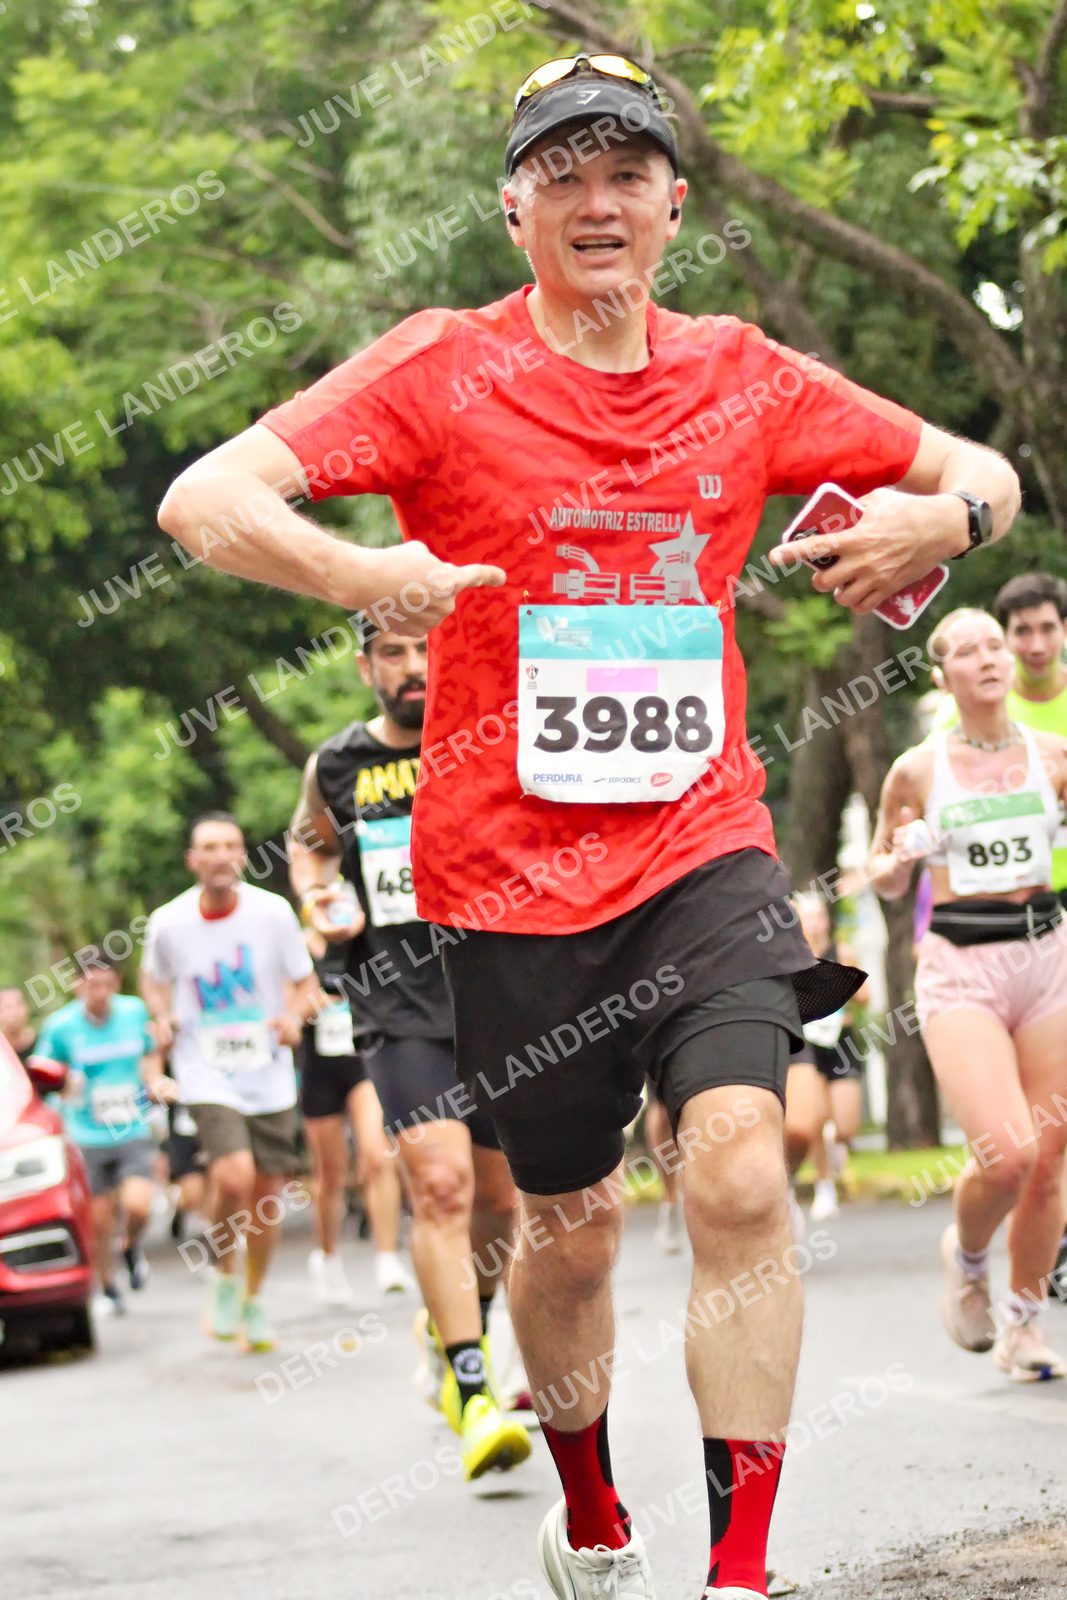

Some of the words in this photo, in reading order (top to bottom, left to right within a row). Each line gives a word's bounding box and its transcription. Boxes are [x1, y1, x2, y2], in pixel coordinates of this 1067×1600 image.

[551, 506, 624, 530] AUTOMOTRIZ
[627, 512, 682, 533] ESTRELLA
[533, 695, 713, 753] 3988
[533, 773, 583, 783] PERDURA
[608, 776, 642, 784] BROOKS
[968, 837, 1033, 867] 893
